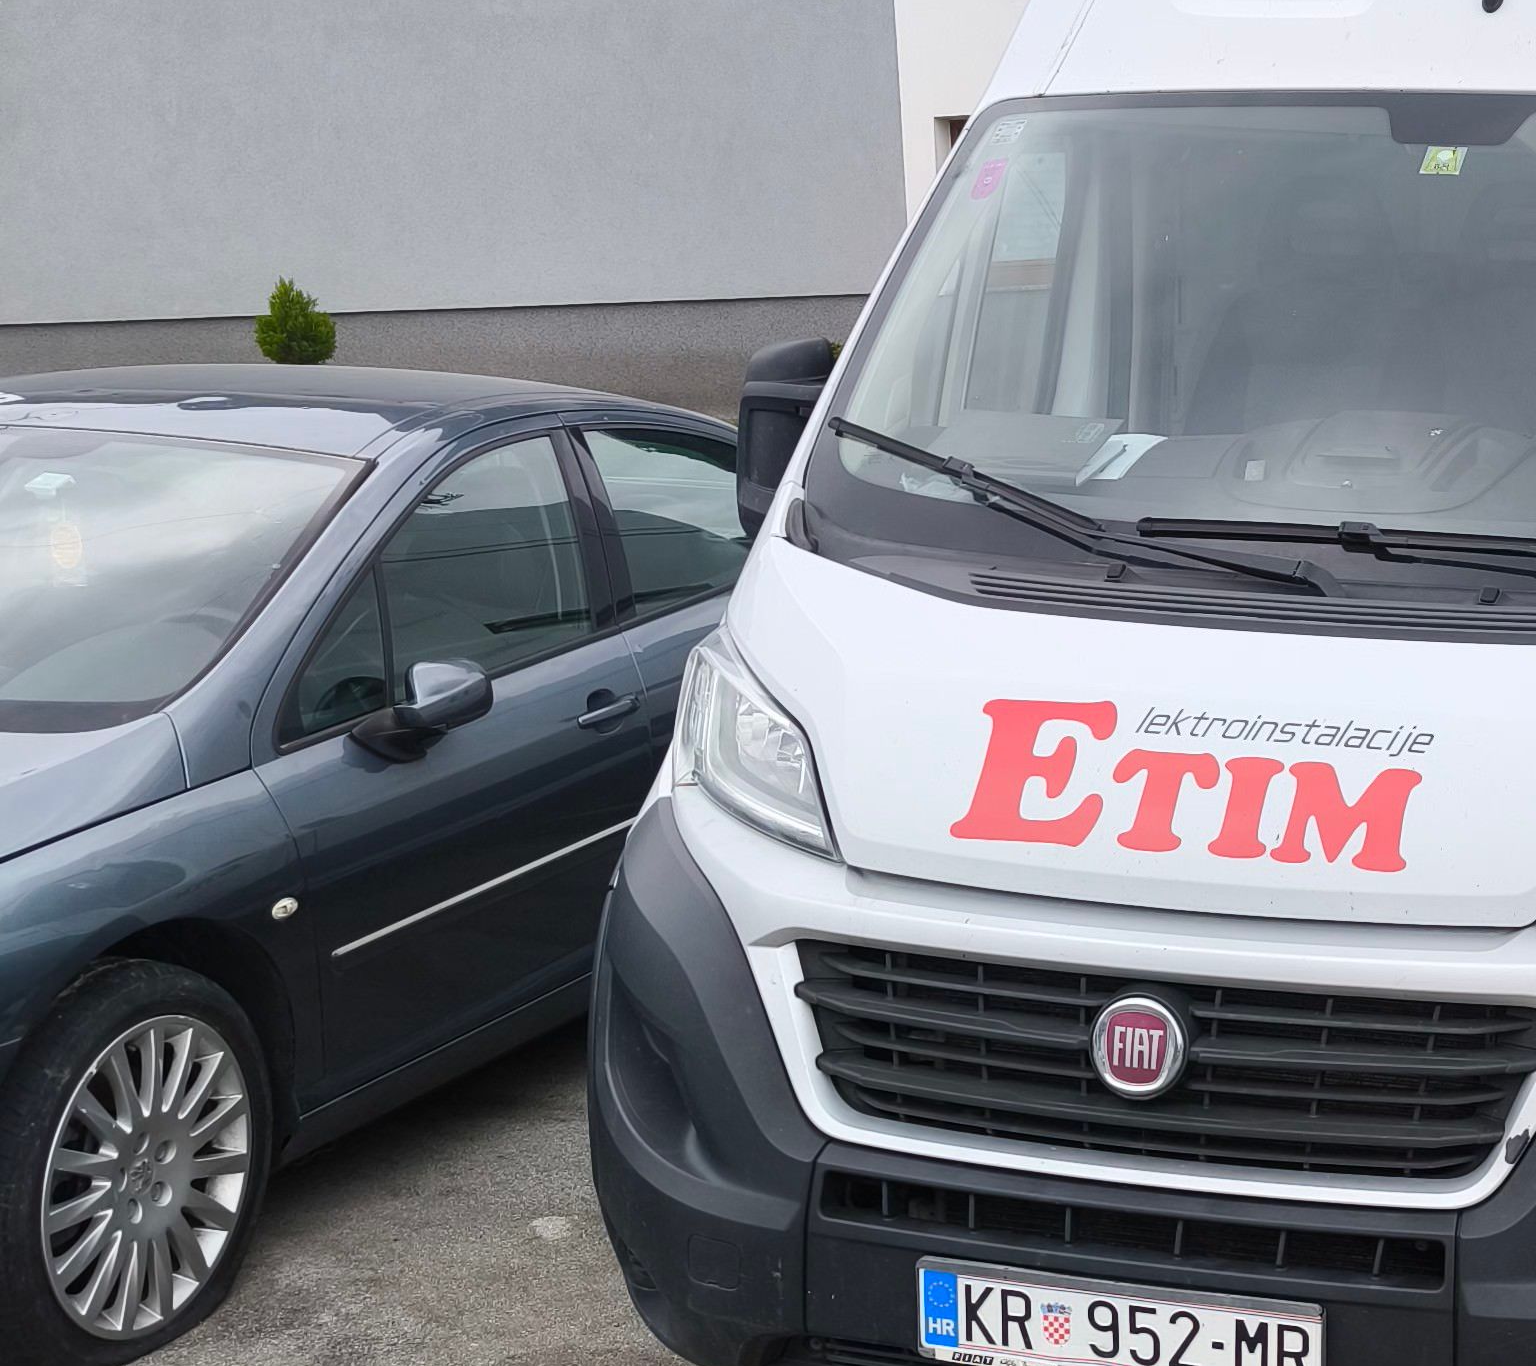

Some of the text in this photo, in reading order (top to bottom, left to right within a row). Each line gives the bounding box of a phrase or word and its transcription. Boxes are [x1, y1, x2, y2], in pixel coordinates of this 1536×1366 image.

[1135, 706, 1434, 757] lektroinstalacije
[1112, 1025, 1164, 1070] FIAT
[928, 1317, 955, 1336] HR
[964, 1283, 1032, 1350] KR
[952, 1352, 994, 1365] FIAT
